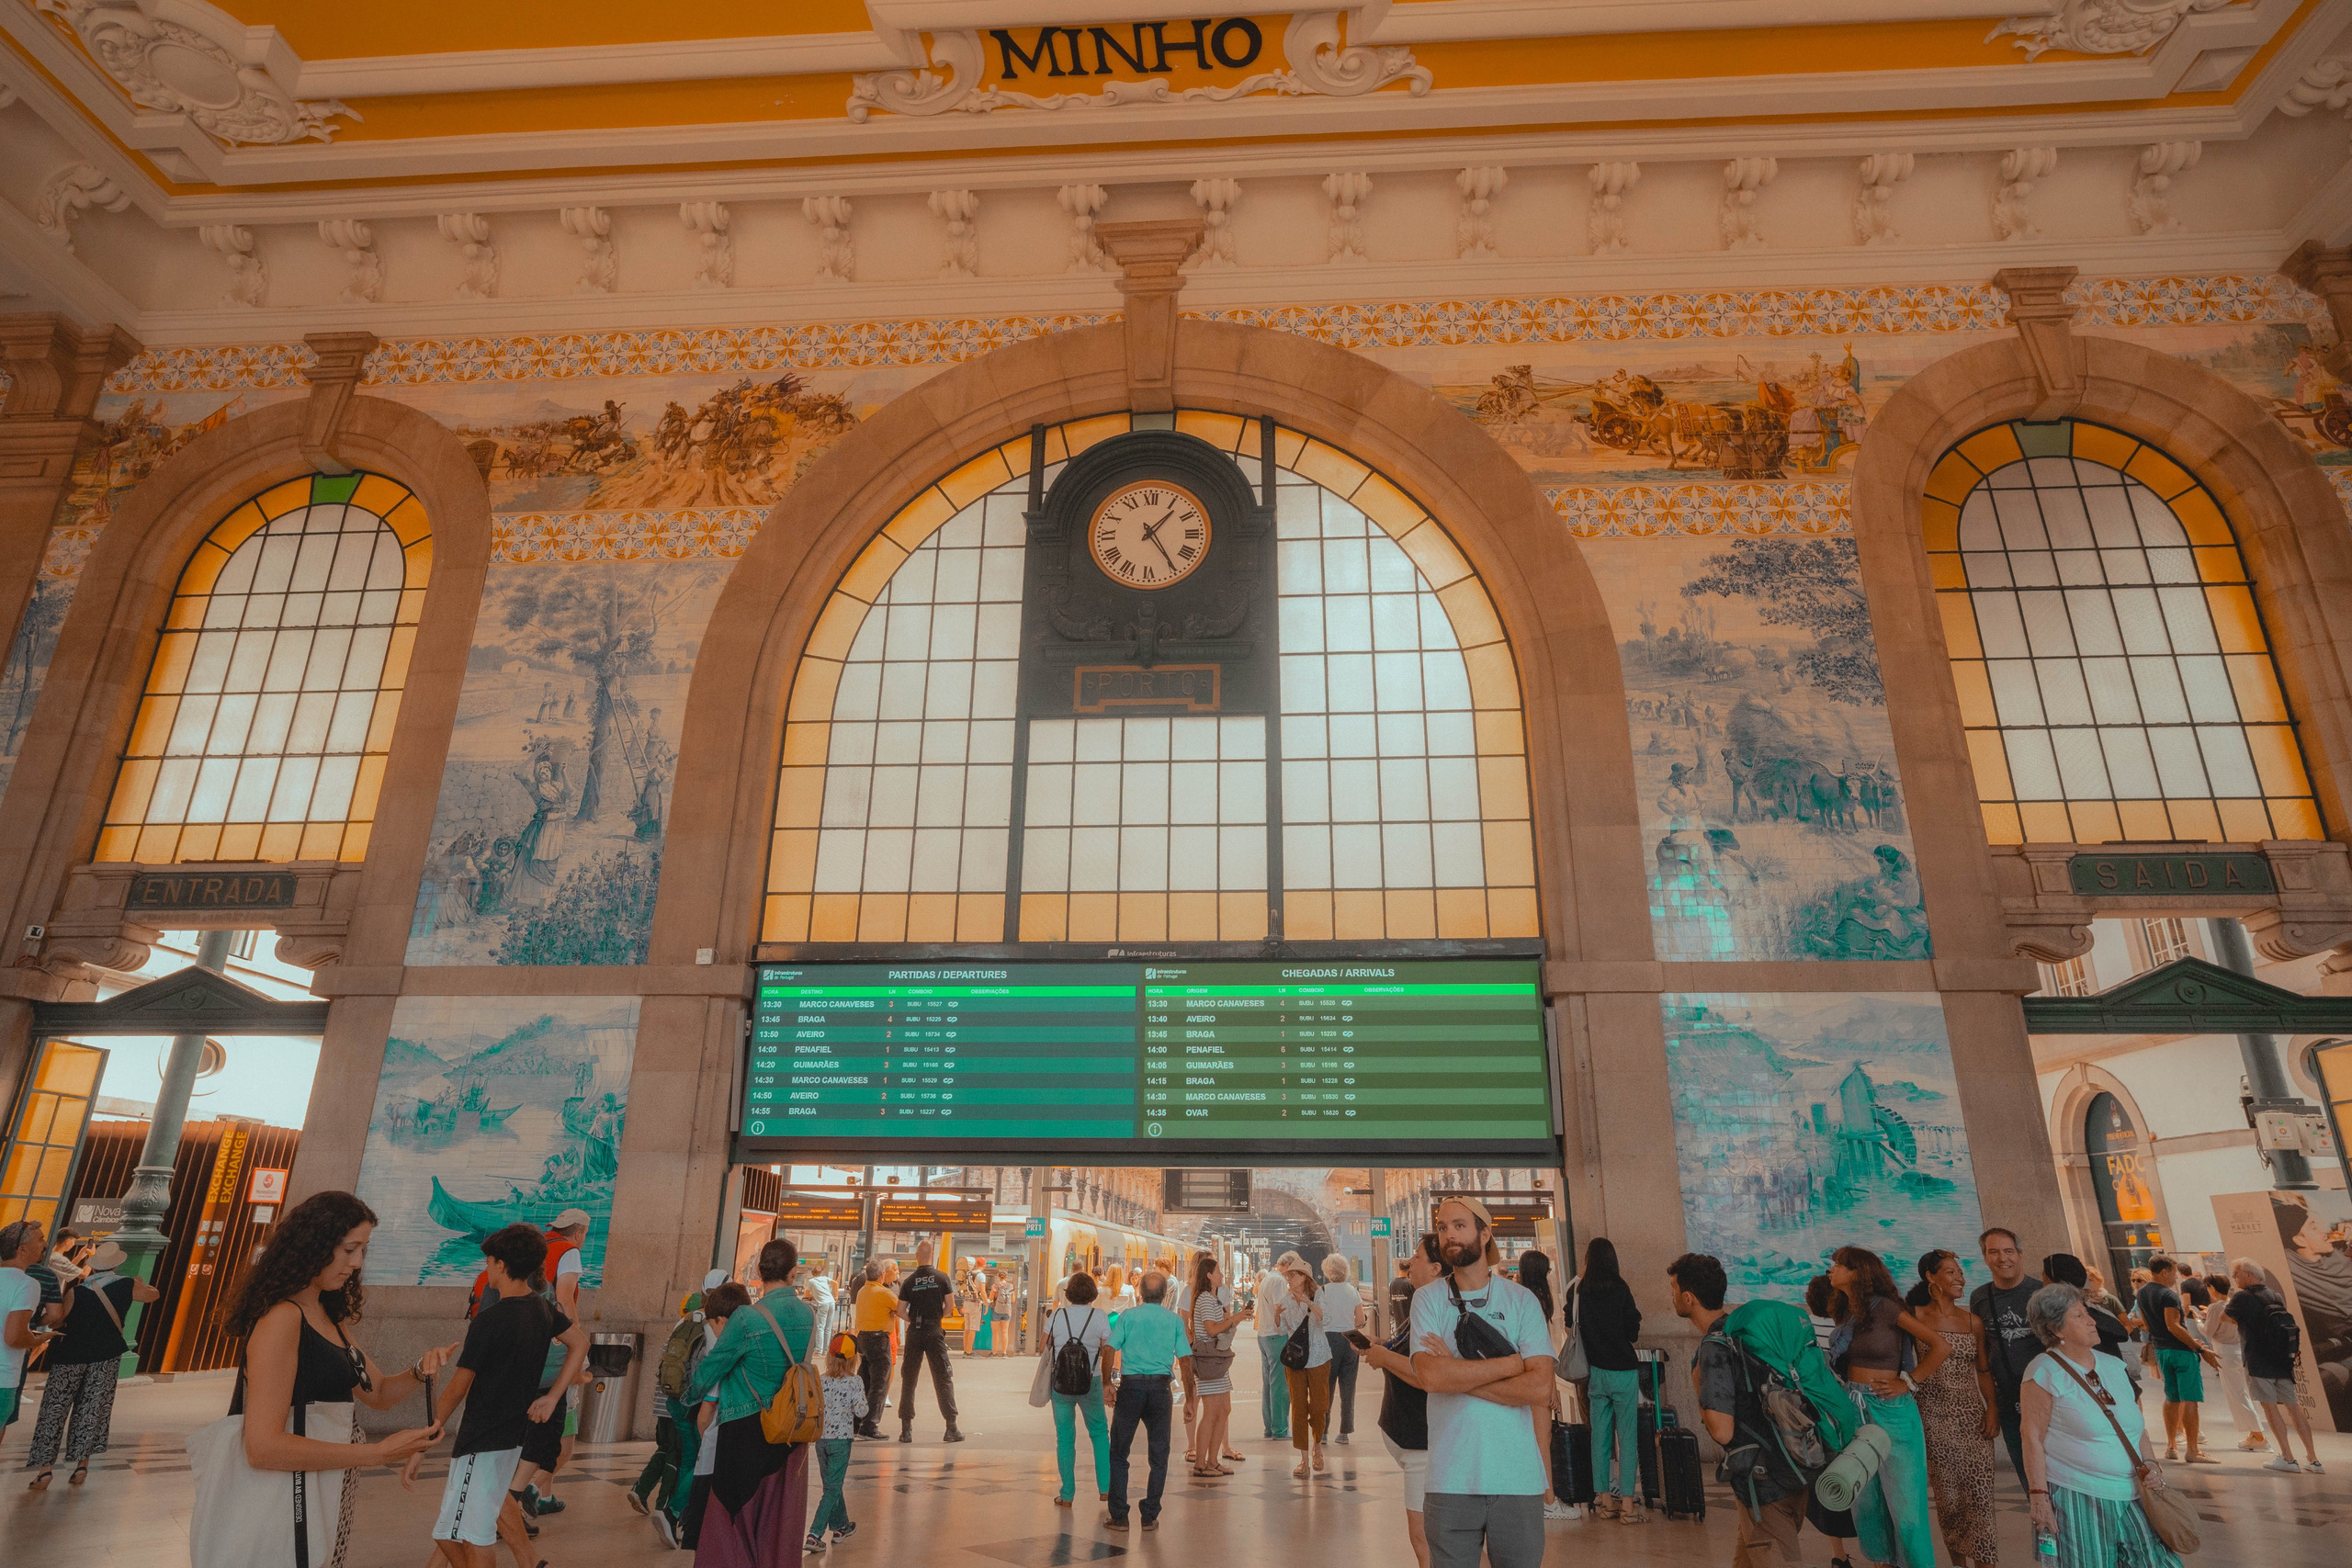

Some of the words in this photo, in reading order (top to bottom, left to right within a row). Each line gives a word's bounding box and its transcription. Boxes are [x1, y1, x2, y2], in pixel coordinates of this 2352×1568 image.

[989, 17, 1262, 79] MINHO
[1143, 493, 1159, 506] XII
[1098, 671, 1196, 696] PORTO
[2096, 860, 2245, 888] SAIDA
[141, 877, 281, 904] ENTRADA
[1283, 969, 1338, 977] CHEGADAS
[794, 1060, 839, 1068] GUIMARÃES
[208, 1131, 234, 1203] EXCHANGE
[220, 1132, 248, 1203] EXCHANGE
[95, 1205, 121, 1216] Nova
[915, 1276, 934, 1285] PSG
